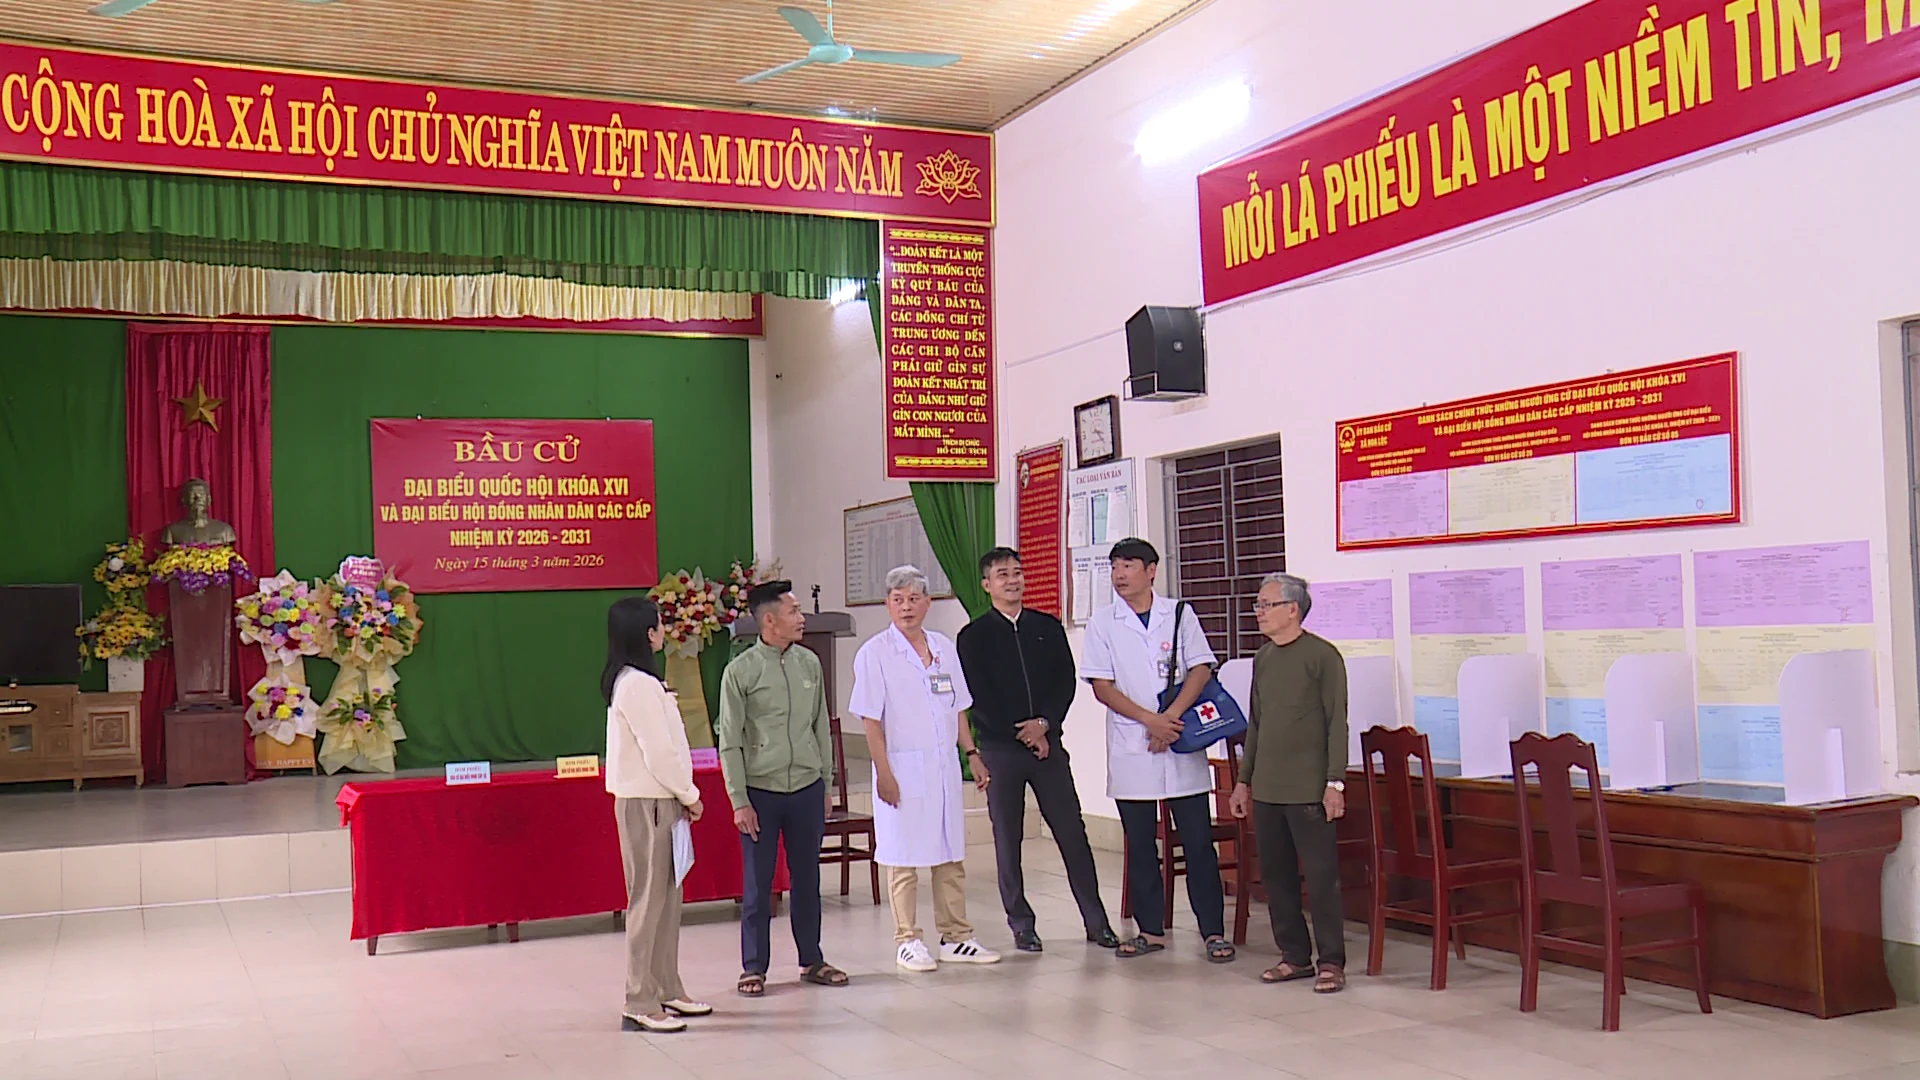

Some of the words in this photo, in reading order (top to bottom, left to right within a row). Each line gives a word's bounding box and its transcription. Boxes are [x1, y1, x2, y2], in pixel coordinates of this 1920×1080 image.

[2, 58, 124, 152] CỘNG
[136, 78, 220, 148] HOÀ
[226, 84, 282, 152] XÃ
[288, 86, 358, 172] HỘI
[368, 91, 442, 164] CHỦ
[447, 109, 568, 173] NGHĨA
[568, 113, 648, 192] VIỆT
[654, 131, 731, 184] NAM
[735, 127, 828, 192] MUÔN
[834, 134, 903, 198] NĂM
[1222, 171, 1275, 269] MỖI
[1282, 160, 1320, 250] LÁ
[1323, 116, 1421, 234] PHIẾU
[1428, 98, 1478, 198] LÀ
[1484, 66, 1572, 182] MỘT
[1584, 4, 1712, 143] NIỀM
[1725, 0, 1841, 91] TIN,
[929, 246, 947, 258] KẾT
[950, 247, 961, 260] LÀ
[964, 248, 984, 262] MỘT
[891, 261, 929, 274] TRUYỀN
[931, 262, 964, 276] THỐNG
[966, 266, 984, 279] CỰC
[891, 276, 905, 290] KỲ
[938, 279, 958, 292] BÁU
[964, 280, 984, 294] CỦA
[926, 294, 940, 307] VÀ
[946, 296, 967, 308] DÂN
[891, 308, 912, 322] CÁC
[950, 312, 968, 324] CHÍ
[972, 312, 985, 325] TỪ
[892, 328, 928, 338] TRUNG
[932, 328, 960, 340] ƯƠNG
[892, 342, 913, 355] CÁC
[919, 345, 939, 356] CHI
[945, 344, 959, 358] BỘ
[893, 358, 920, 372] PHẢI
[924, 359, 943, 372] GIỮ
[948, 360, 966, 373] GÌN
[972, 361, 986, 376] SỰ
[893, 374, 920, 387] ĐOÀN
[922, 376, 941, 388] KẾT
[943, 376, 969, 389] NHẤT
[971, 378, 986, 390] TRÍ
[893, 390, 914, 404] CỦA
[919, 391, 945, 405] ĐẢNG
[947, 394, 968, 405] NHƯ
[970, 393, 987, 406] GIỮ
[893, 407, 910, 420] GÌN
[913, 411, 932, 421] CON
[967, 408, 986, 422] CỦA
[894, 422, 914, 437] MẮT
[453, 431, 524, 462] BẦU
[532, 435, 580, 462] CỬ
[404, 478, 432, 500] ĐẠI
[438, 472, 474, 496] BIỂU
[479, 473, 522, 498] QUỐC
[527, 475, 552, 500] HỘI
[557, 477, 599, 496] KHÓA
[603, 478, 628, 496] XVI
[381, 502, 399, 521] VÀ
[402, 505, 425, 524] ĐẠI
[429, 499, 459, 521] BIỂU
[463, 503, 485, 524] HỘI
[488, 500, 525, 520] ĐỒNG
[528, 502, 565, 520] NHÂN
[568, 501, 594, 520] DÂN
[597, 501, 622, 519] CÁC
[626, 498, 651, 519] CẤP
[450, 529, 494, 549] NHIỆM
[497, 528, 514, 546] KỲ
[517, 530, 549, 545] 2026
[561, 529, 591, 544] 2031
[434, 556, 469, 572] Ngày
[474, 556, 487, 568] 15
[492, 555, 528, 571] tháng
[531, 556, 539, 567] 3
[543, 557, 570, 568] năm
[573, 555, 604, 566] 2026
